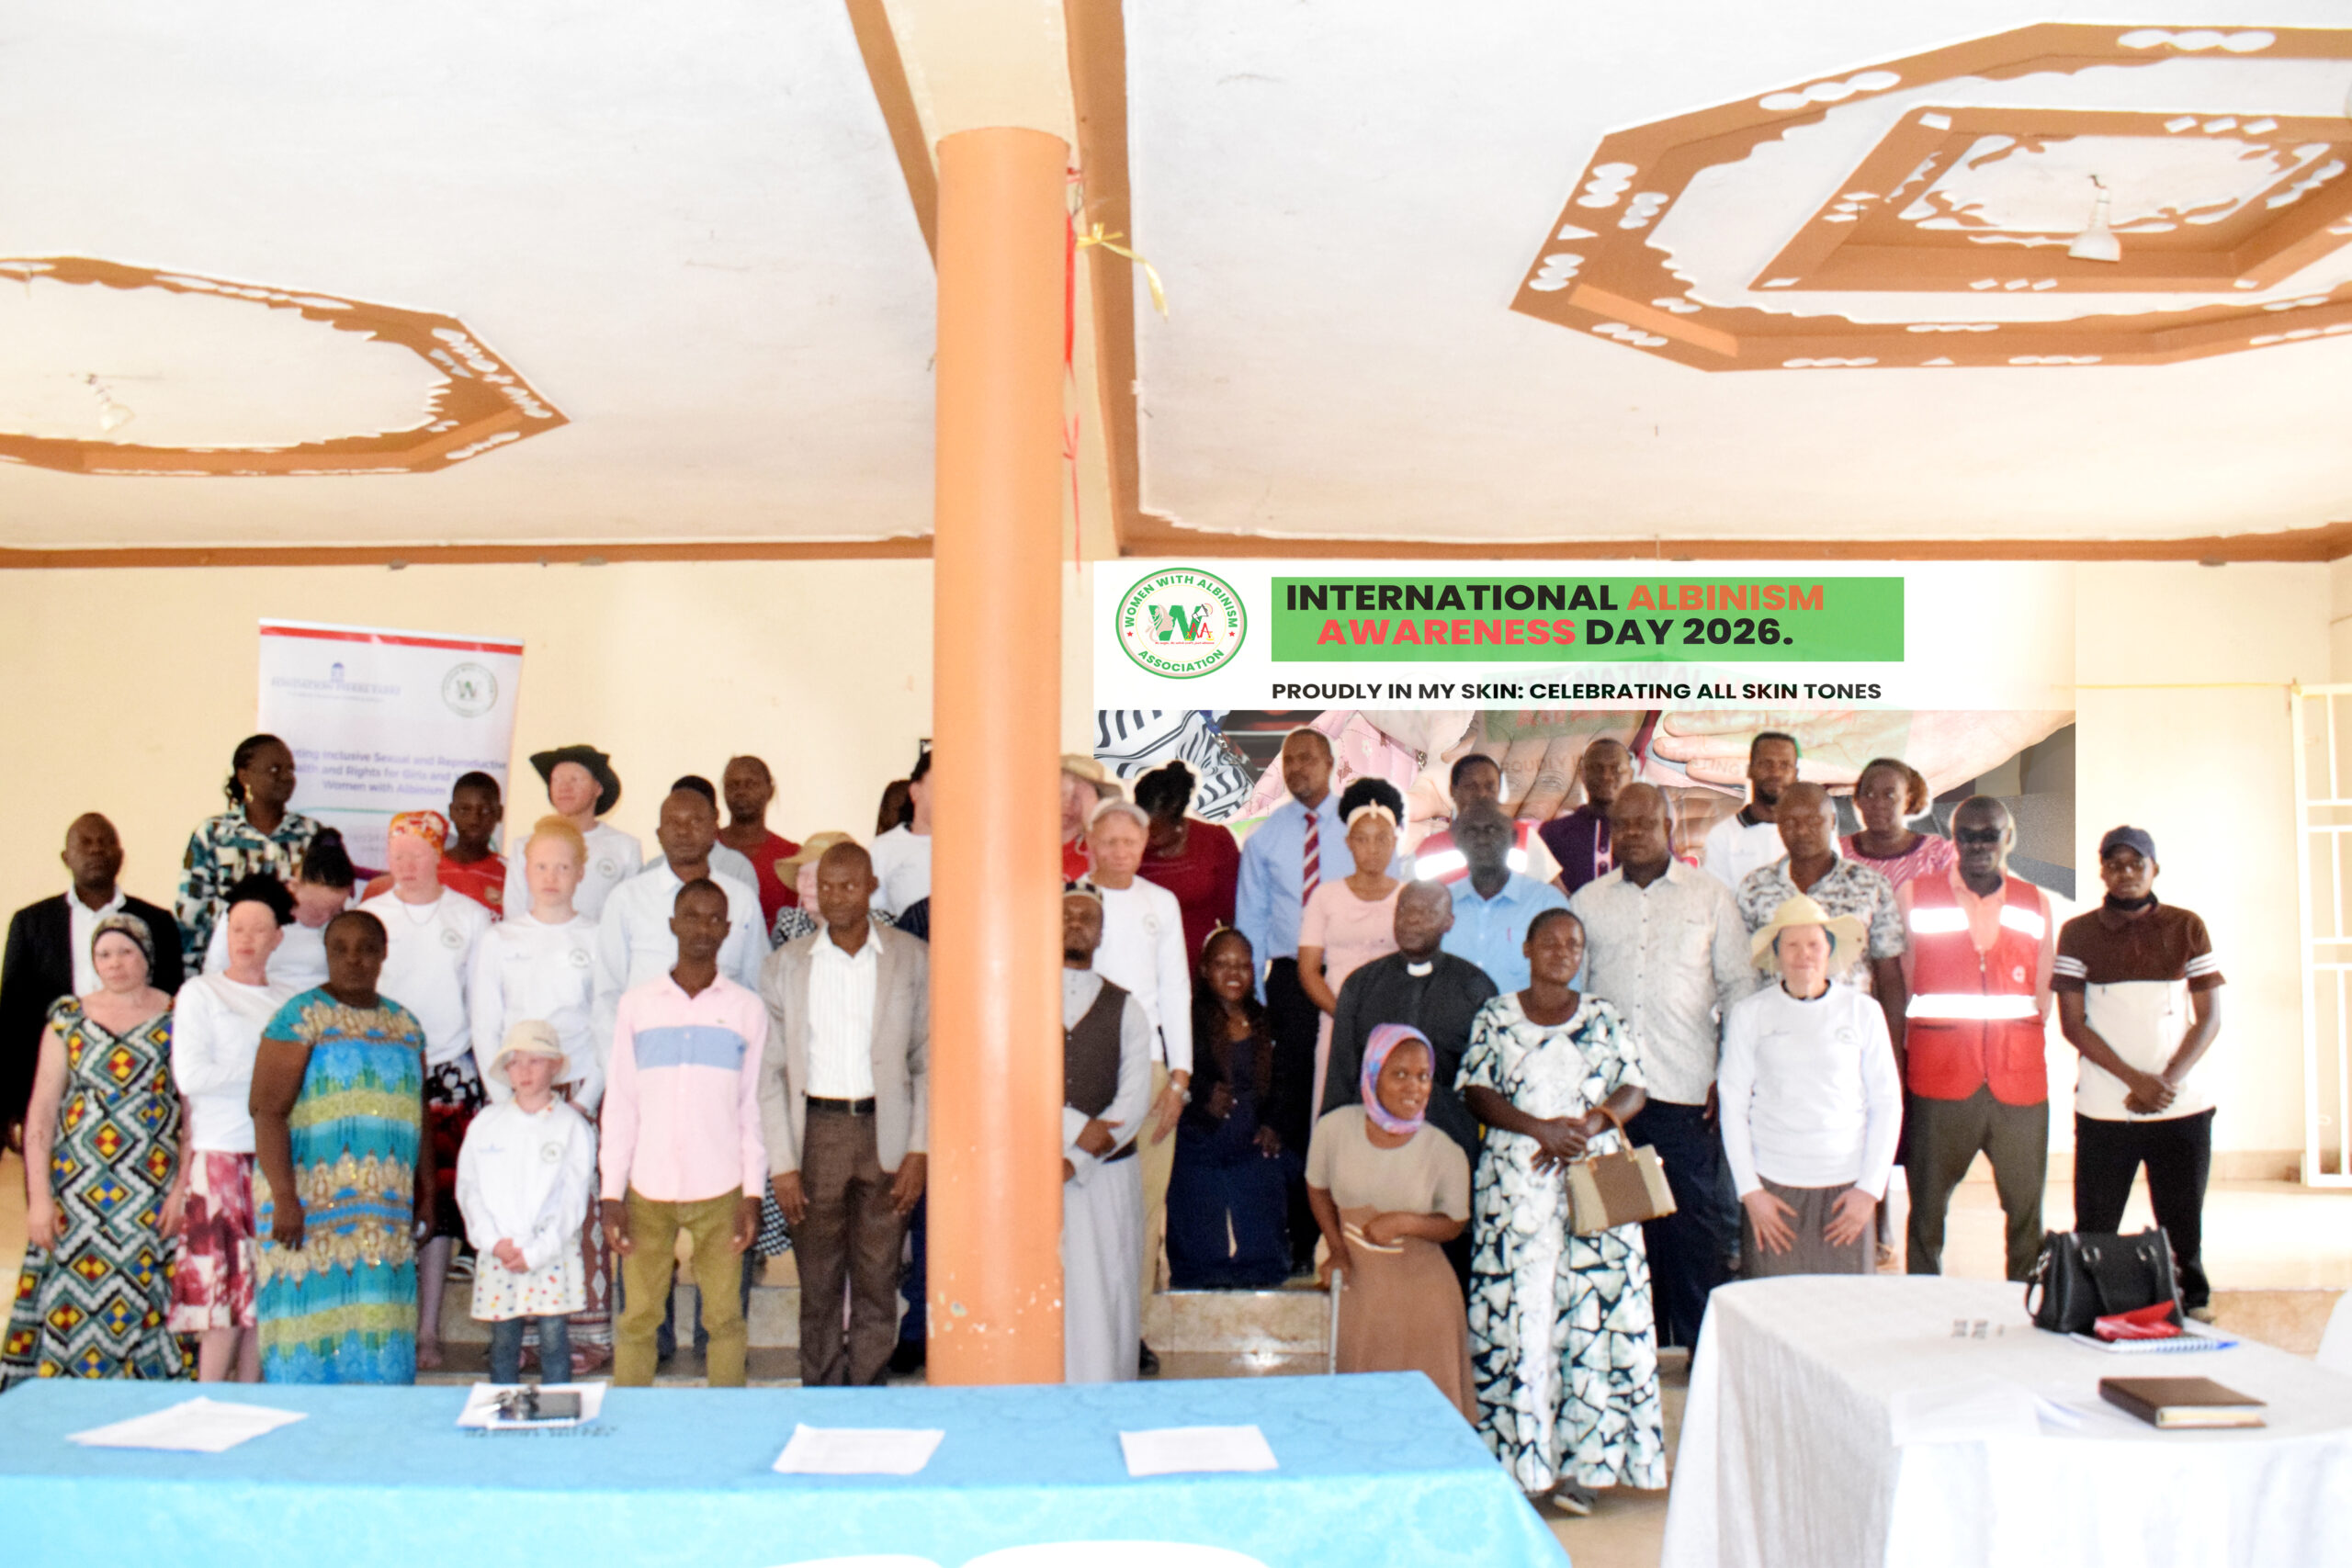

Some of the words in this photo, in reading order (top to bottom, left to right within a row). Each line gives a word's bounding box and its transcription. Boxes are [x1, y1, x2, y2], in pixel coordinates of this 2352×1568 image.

[322, 750, 370, 762] Inclusive
[322, 765, 343, 775] and
[346, 766, 380, 779] Rights
[323, 780, 367, 792] Women
[369, 781, 394, 793] with
